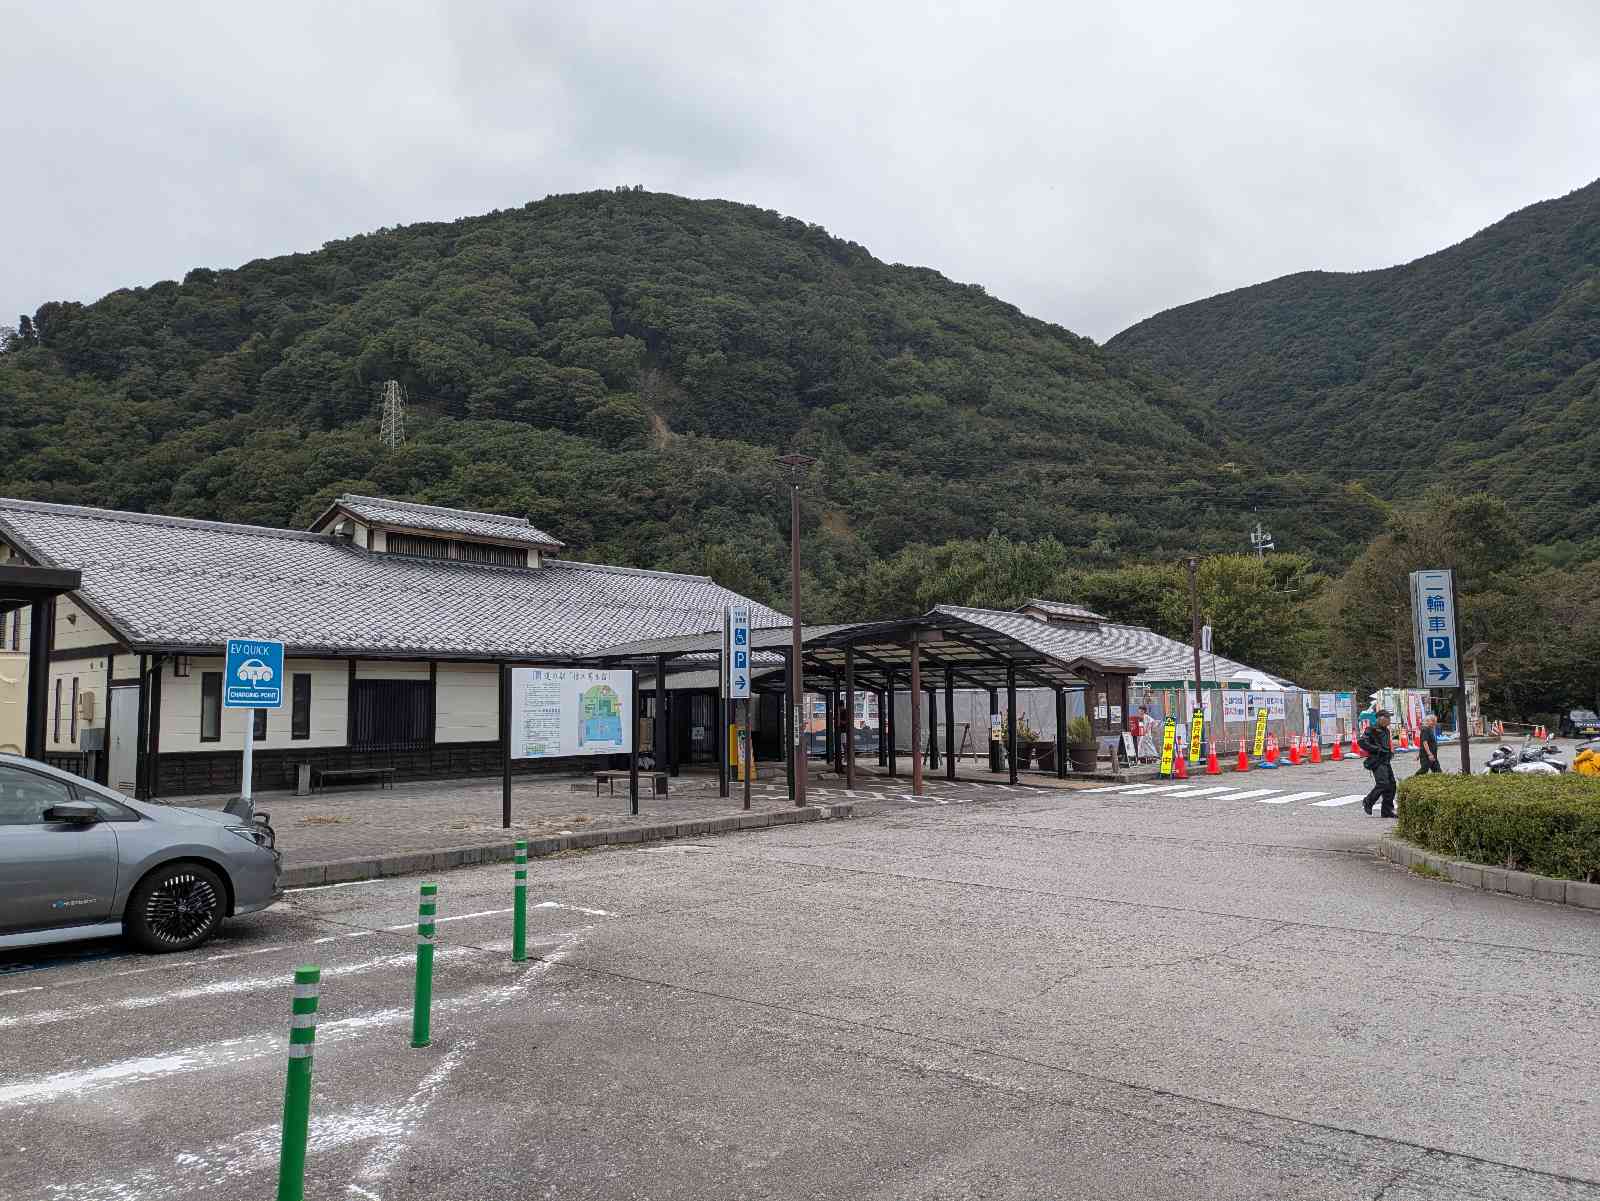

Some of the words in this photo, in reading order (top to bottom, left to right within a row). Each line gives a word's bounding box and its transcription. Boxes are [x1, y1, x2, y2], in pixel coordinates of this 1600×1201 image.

[1425, 575, 1447, 633] 二輪車
[231, 643, 241, 654] EV
[243, 644, 270, 656] QUICK
[1432, 638, 1445, 657] P
[737, 653, 745, 668] P
[1162, 731, 1176, 765] 工事中
